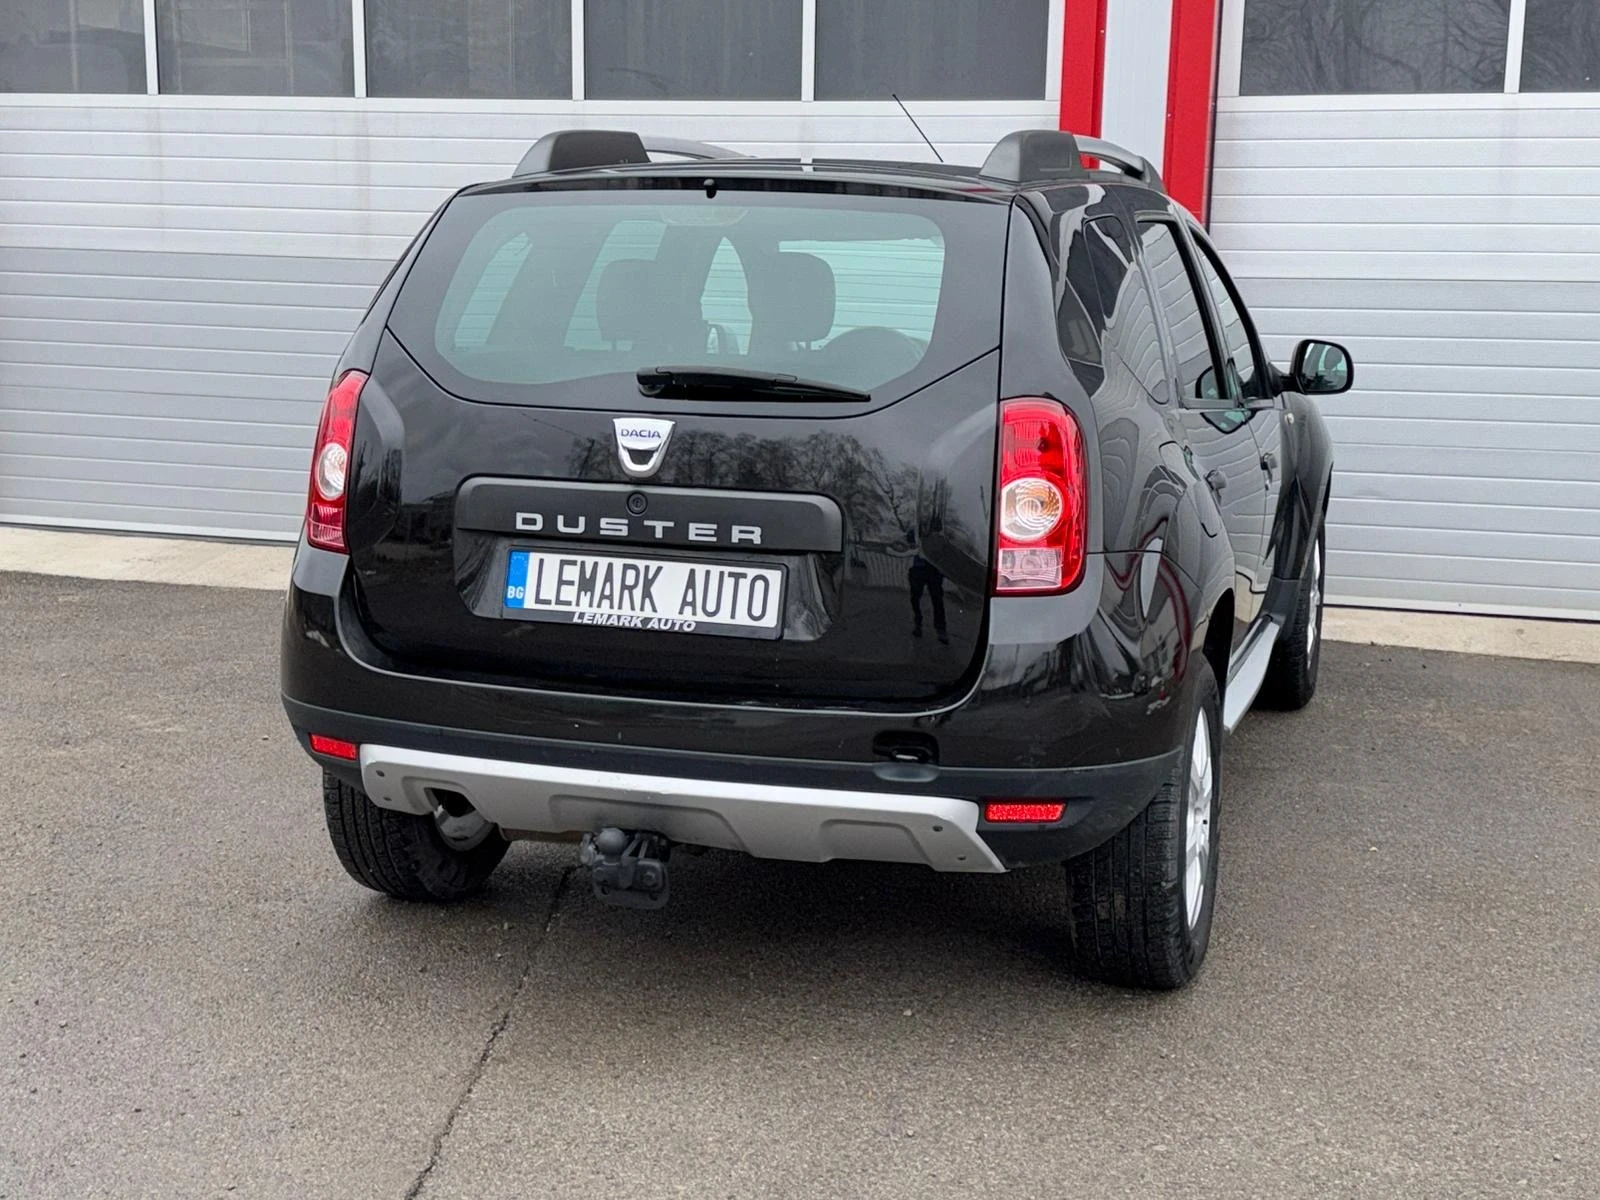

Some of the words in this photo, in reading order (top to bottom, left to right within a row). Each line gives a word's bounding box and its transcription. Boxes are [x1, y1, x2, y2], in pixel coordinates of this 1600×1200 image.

[621, 428, 661, 439] DACIA
[515, 511, 762, 545] DUSTER
[507, 585, 524, 599] BG
[534, 557, 663, 614] LEMARK
[678, 567, 770, 622] AUTO
[573, 611, 643, 630] LEMARK
[647, 617, 696, 633] AUTO
